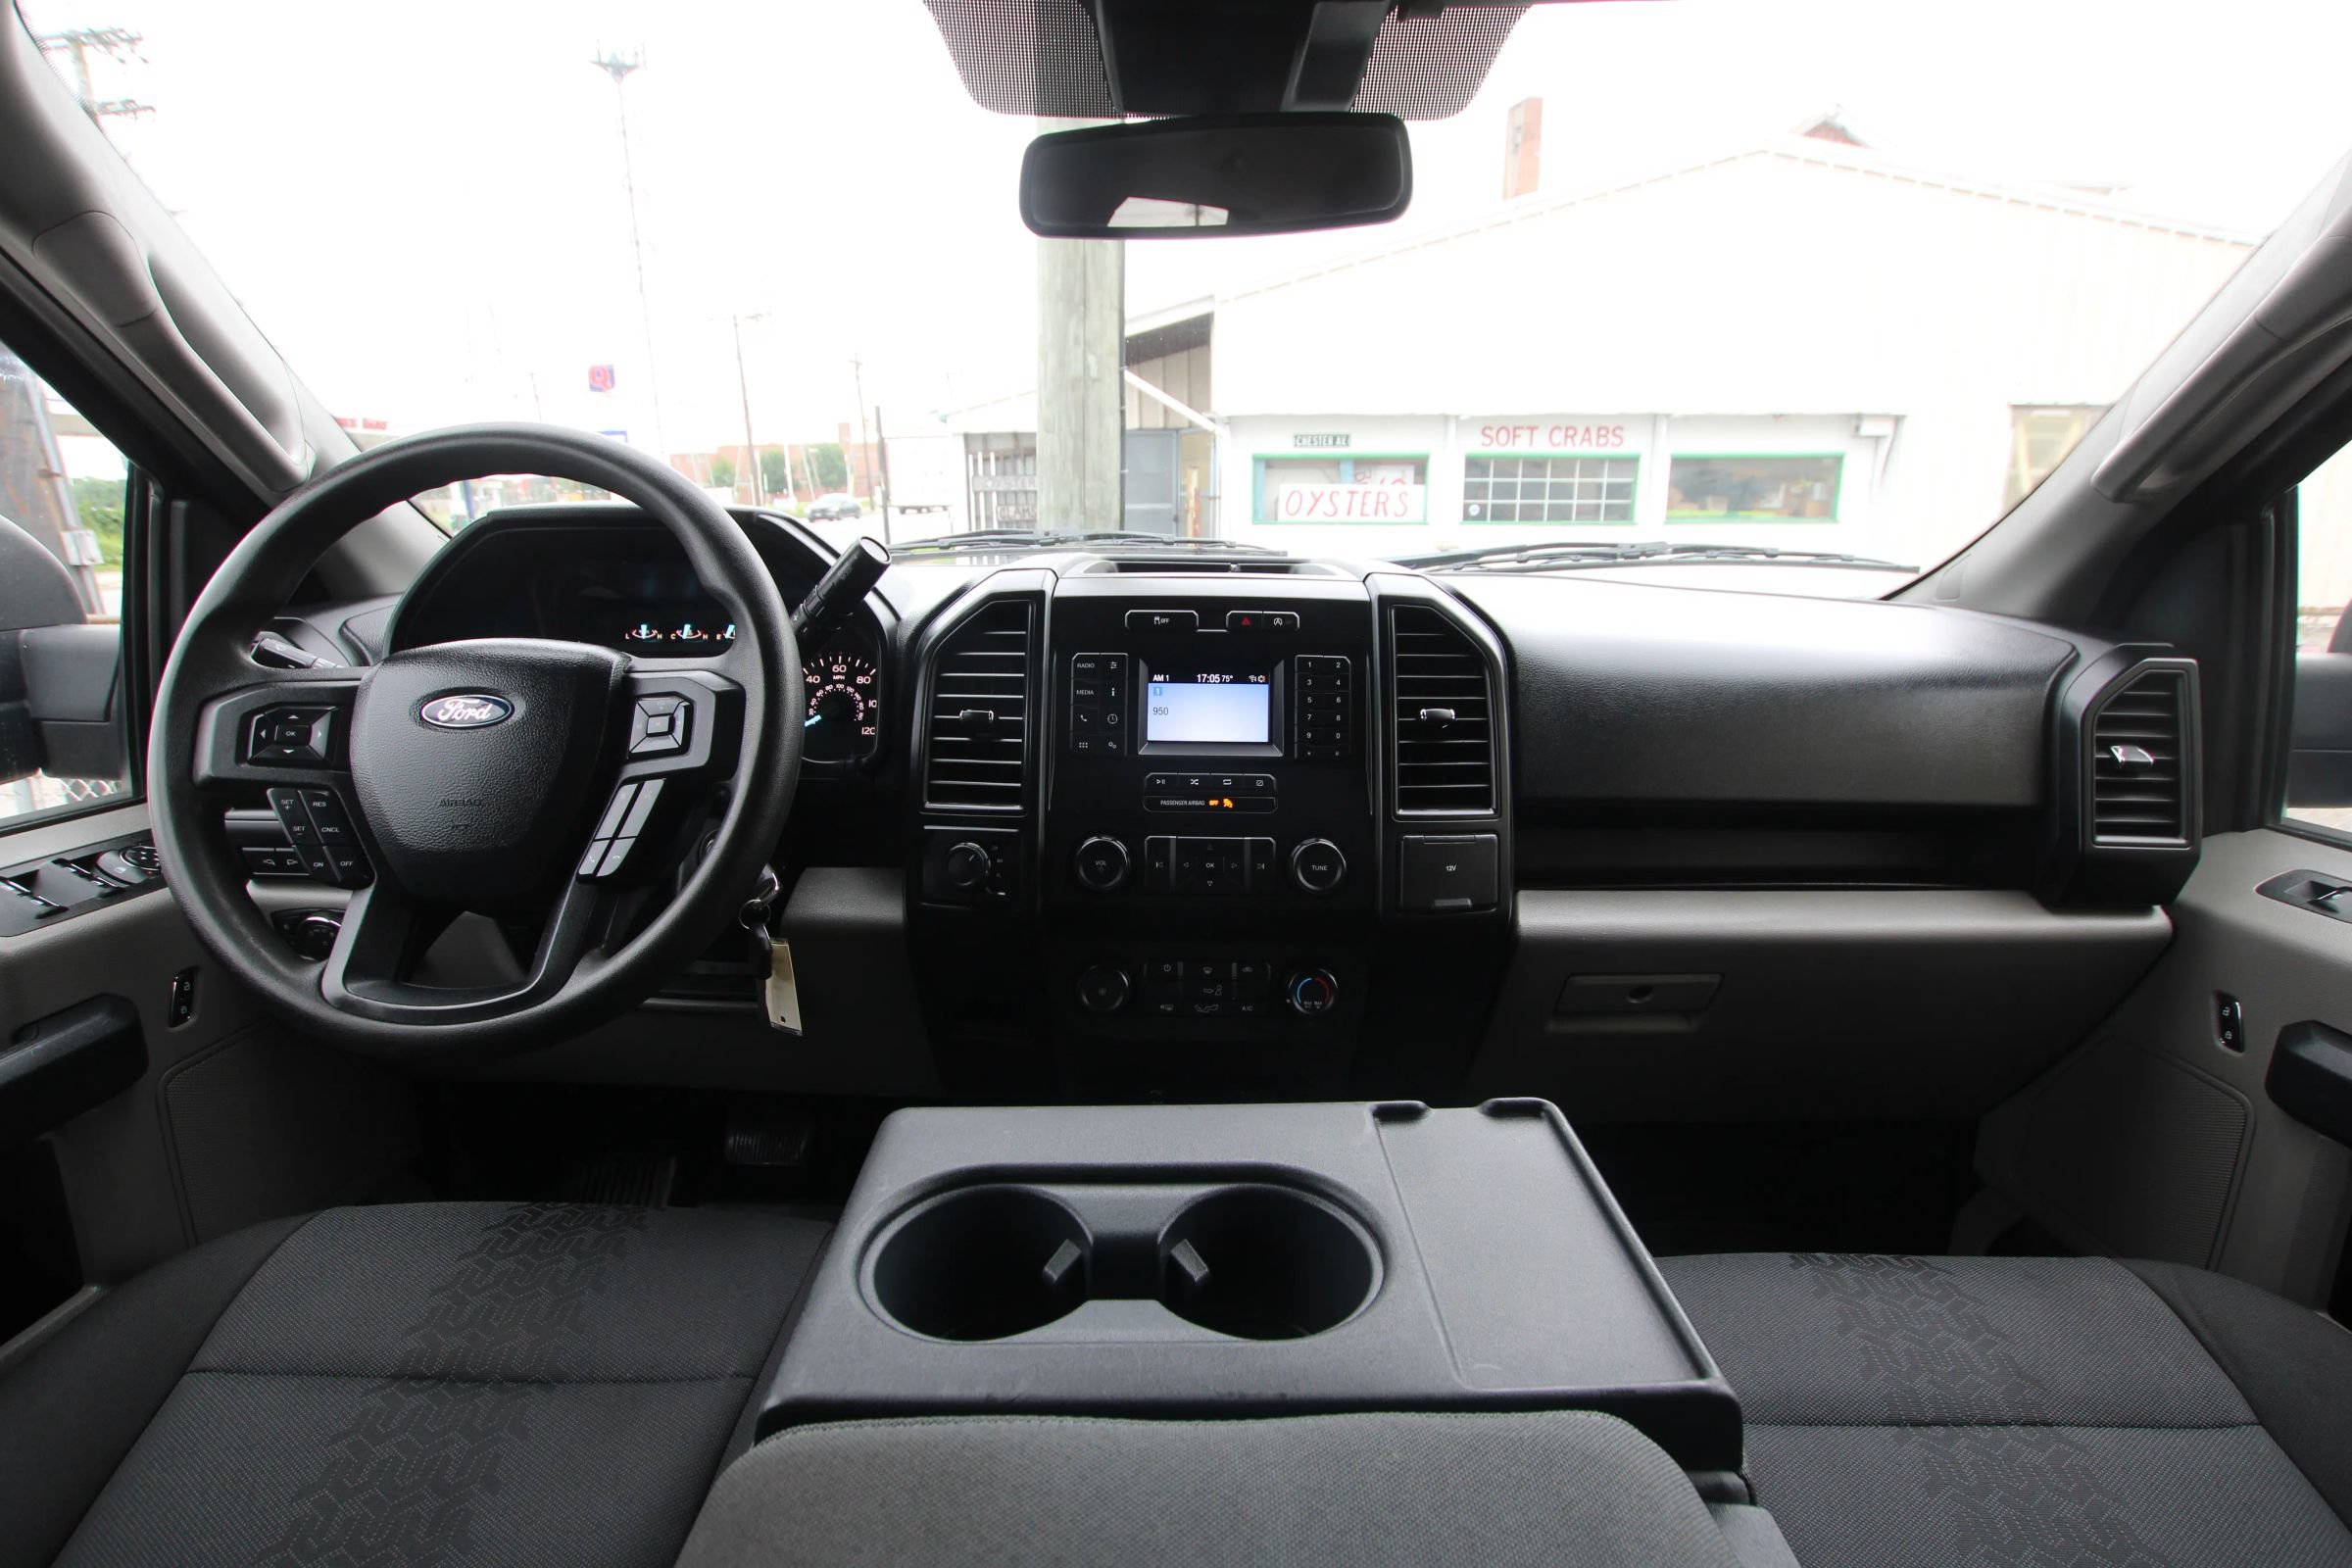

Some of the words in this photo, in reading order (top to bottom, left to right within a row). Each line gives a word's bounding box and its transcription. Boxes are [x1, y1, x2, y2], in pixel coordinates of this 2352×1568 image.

[1296, 435, 1334, 446] CHESTER
[1481, 425, 1540, 447] SOFT
[1547, 425, 1625, 448] CRABS
[1285, 489, 1409, 518] OYSTERS
[806, 675, 820, 684] 40
[857, 675, 871, 684] 80
[1197, 674, 1221, 683] 17:05
[435, 697, 493, 722] Ford
[1152, 707, 1169, 716] 950
